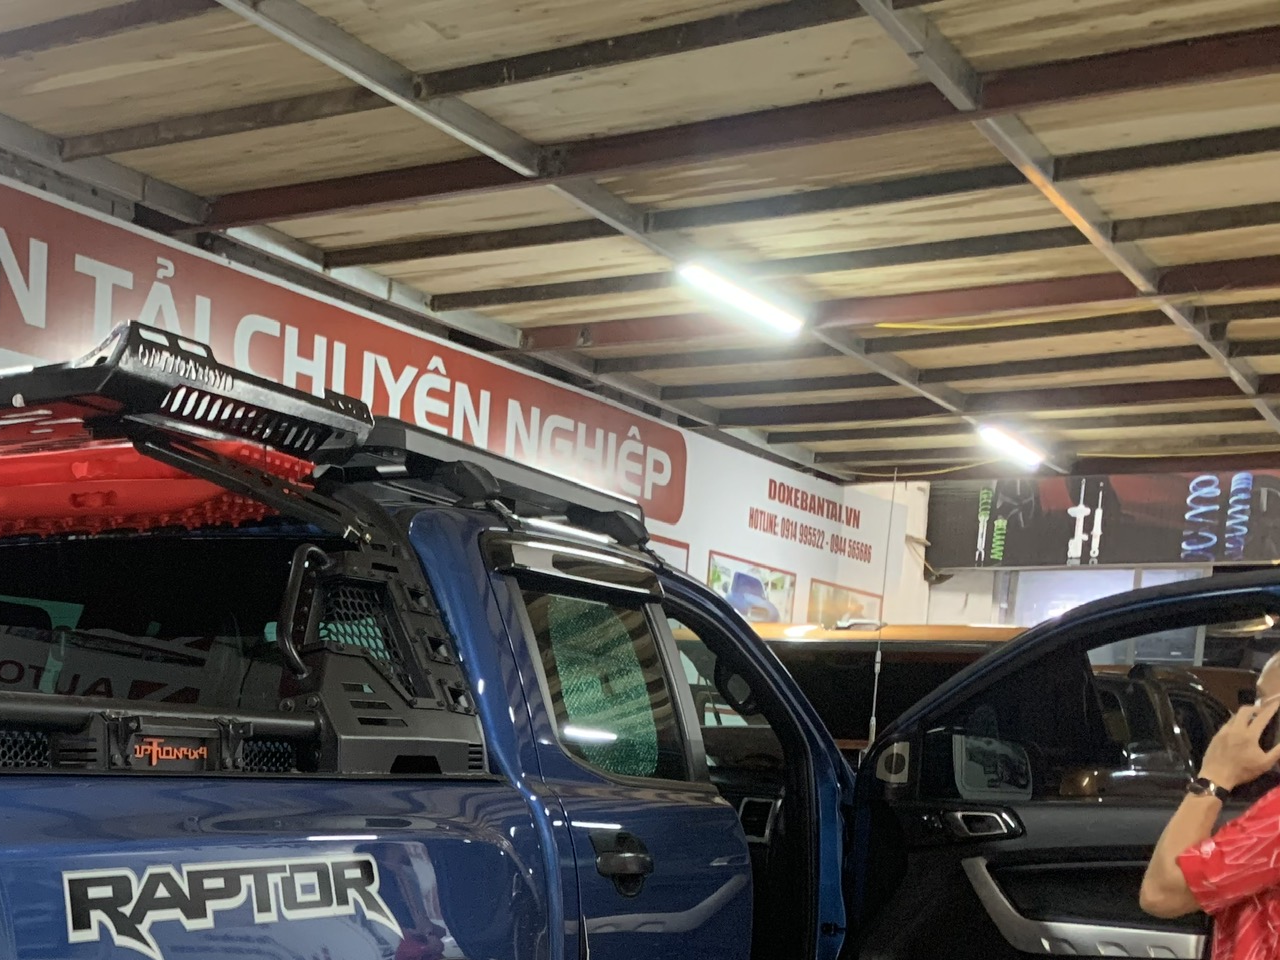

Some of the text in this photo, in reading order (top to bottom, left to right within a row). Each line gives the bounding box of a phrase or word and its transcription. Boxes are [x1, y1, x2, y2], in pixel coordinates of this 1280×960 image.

[234, 314, 490, 452] CHUYÊN
[768, 478, 861, 529] DOXEBANTAI.VN
[748, 507, 779, 535] HOTLINE:
[781, 517, 797, 542] 0914
[799, 524, 825, 549] 995522
[830, 534, 846, 556] 0944
